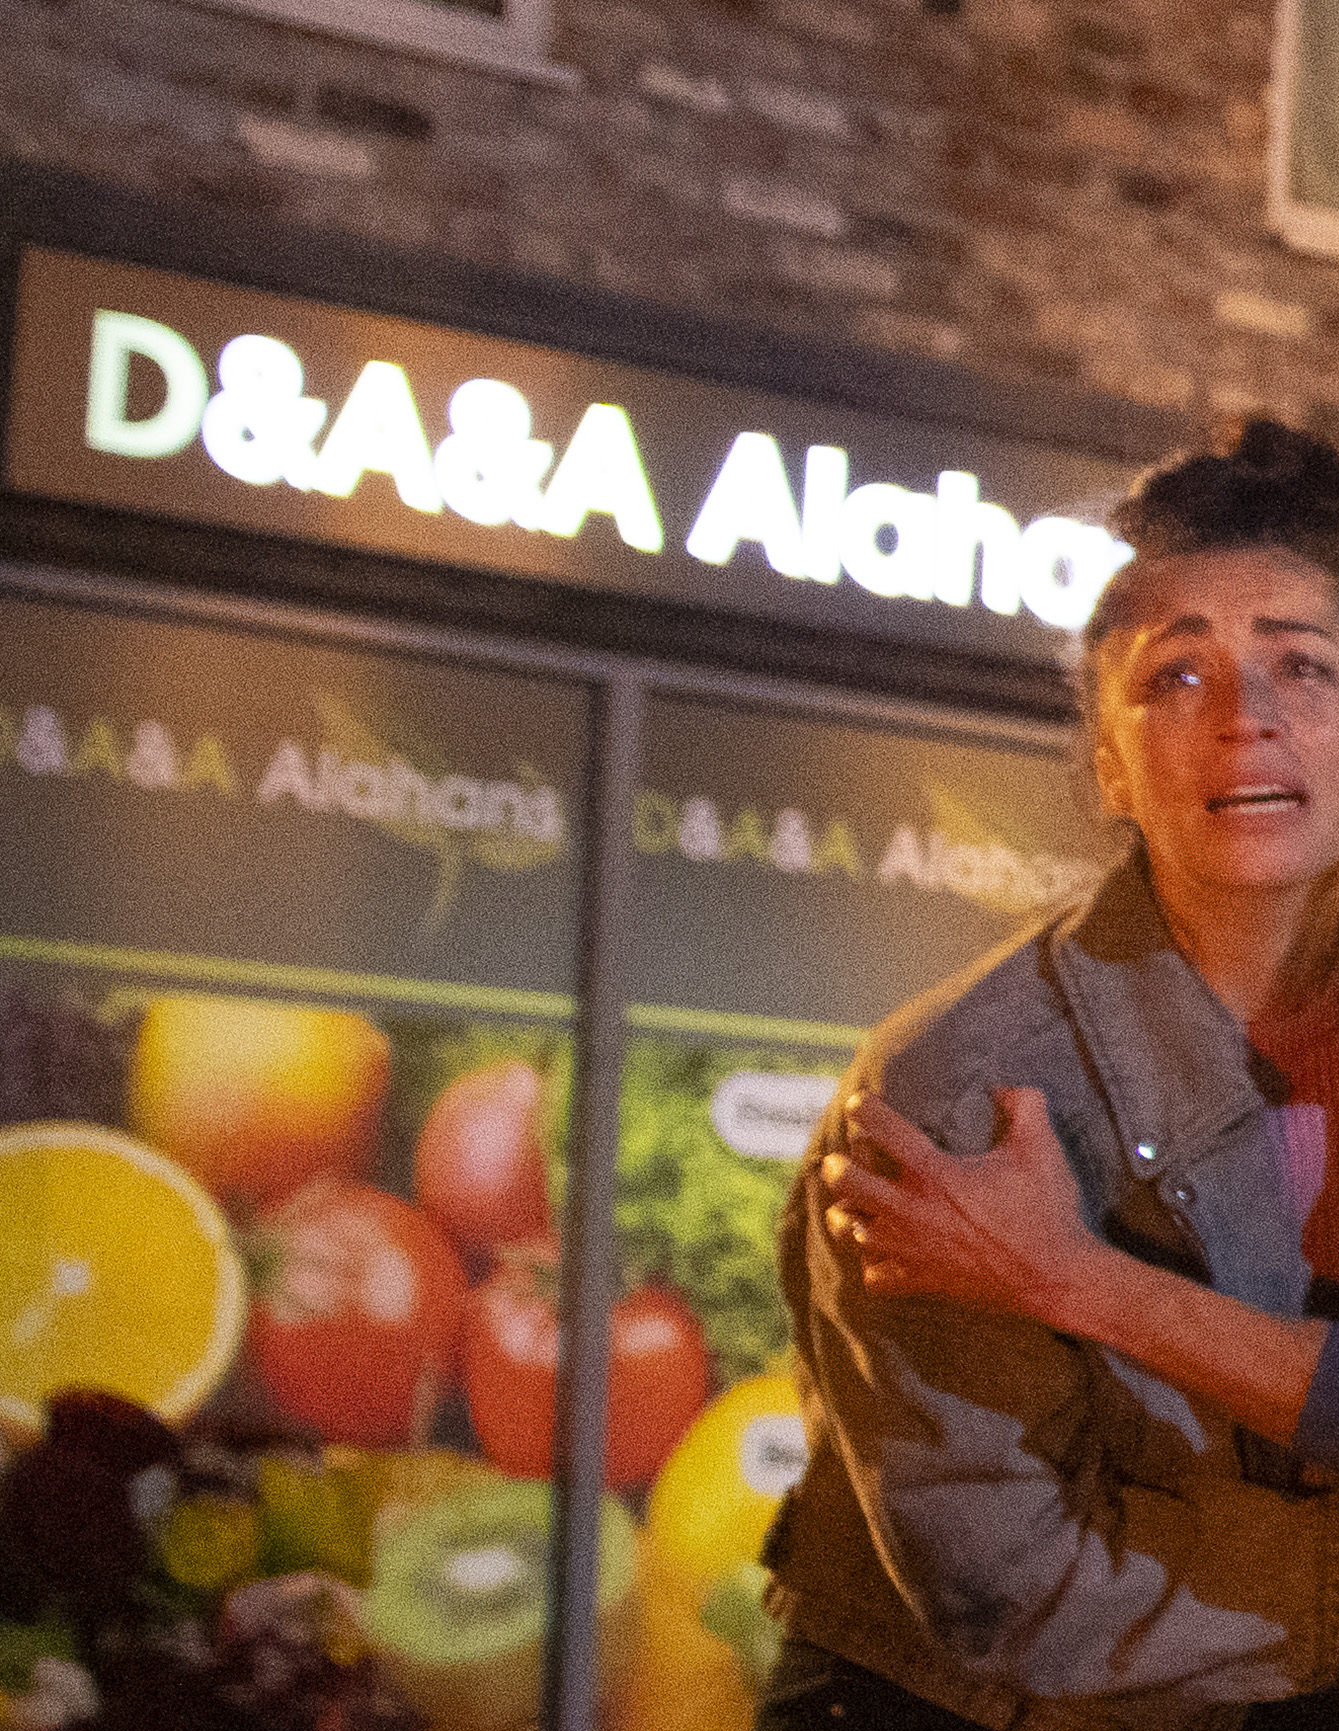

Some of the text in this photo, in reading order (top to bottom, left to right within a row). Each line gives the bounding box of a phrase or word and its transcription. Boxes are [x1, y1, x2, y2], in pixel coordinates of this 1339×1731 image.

[85, 308, 1136, 631] D&A&A Alaha
[633, 789, 859, 879] D&A&A
